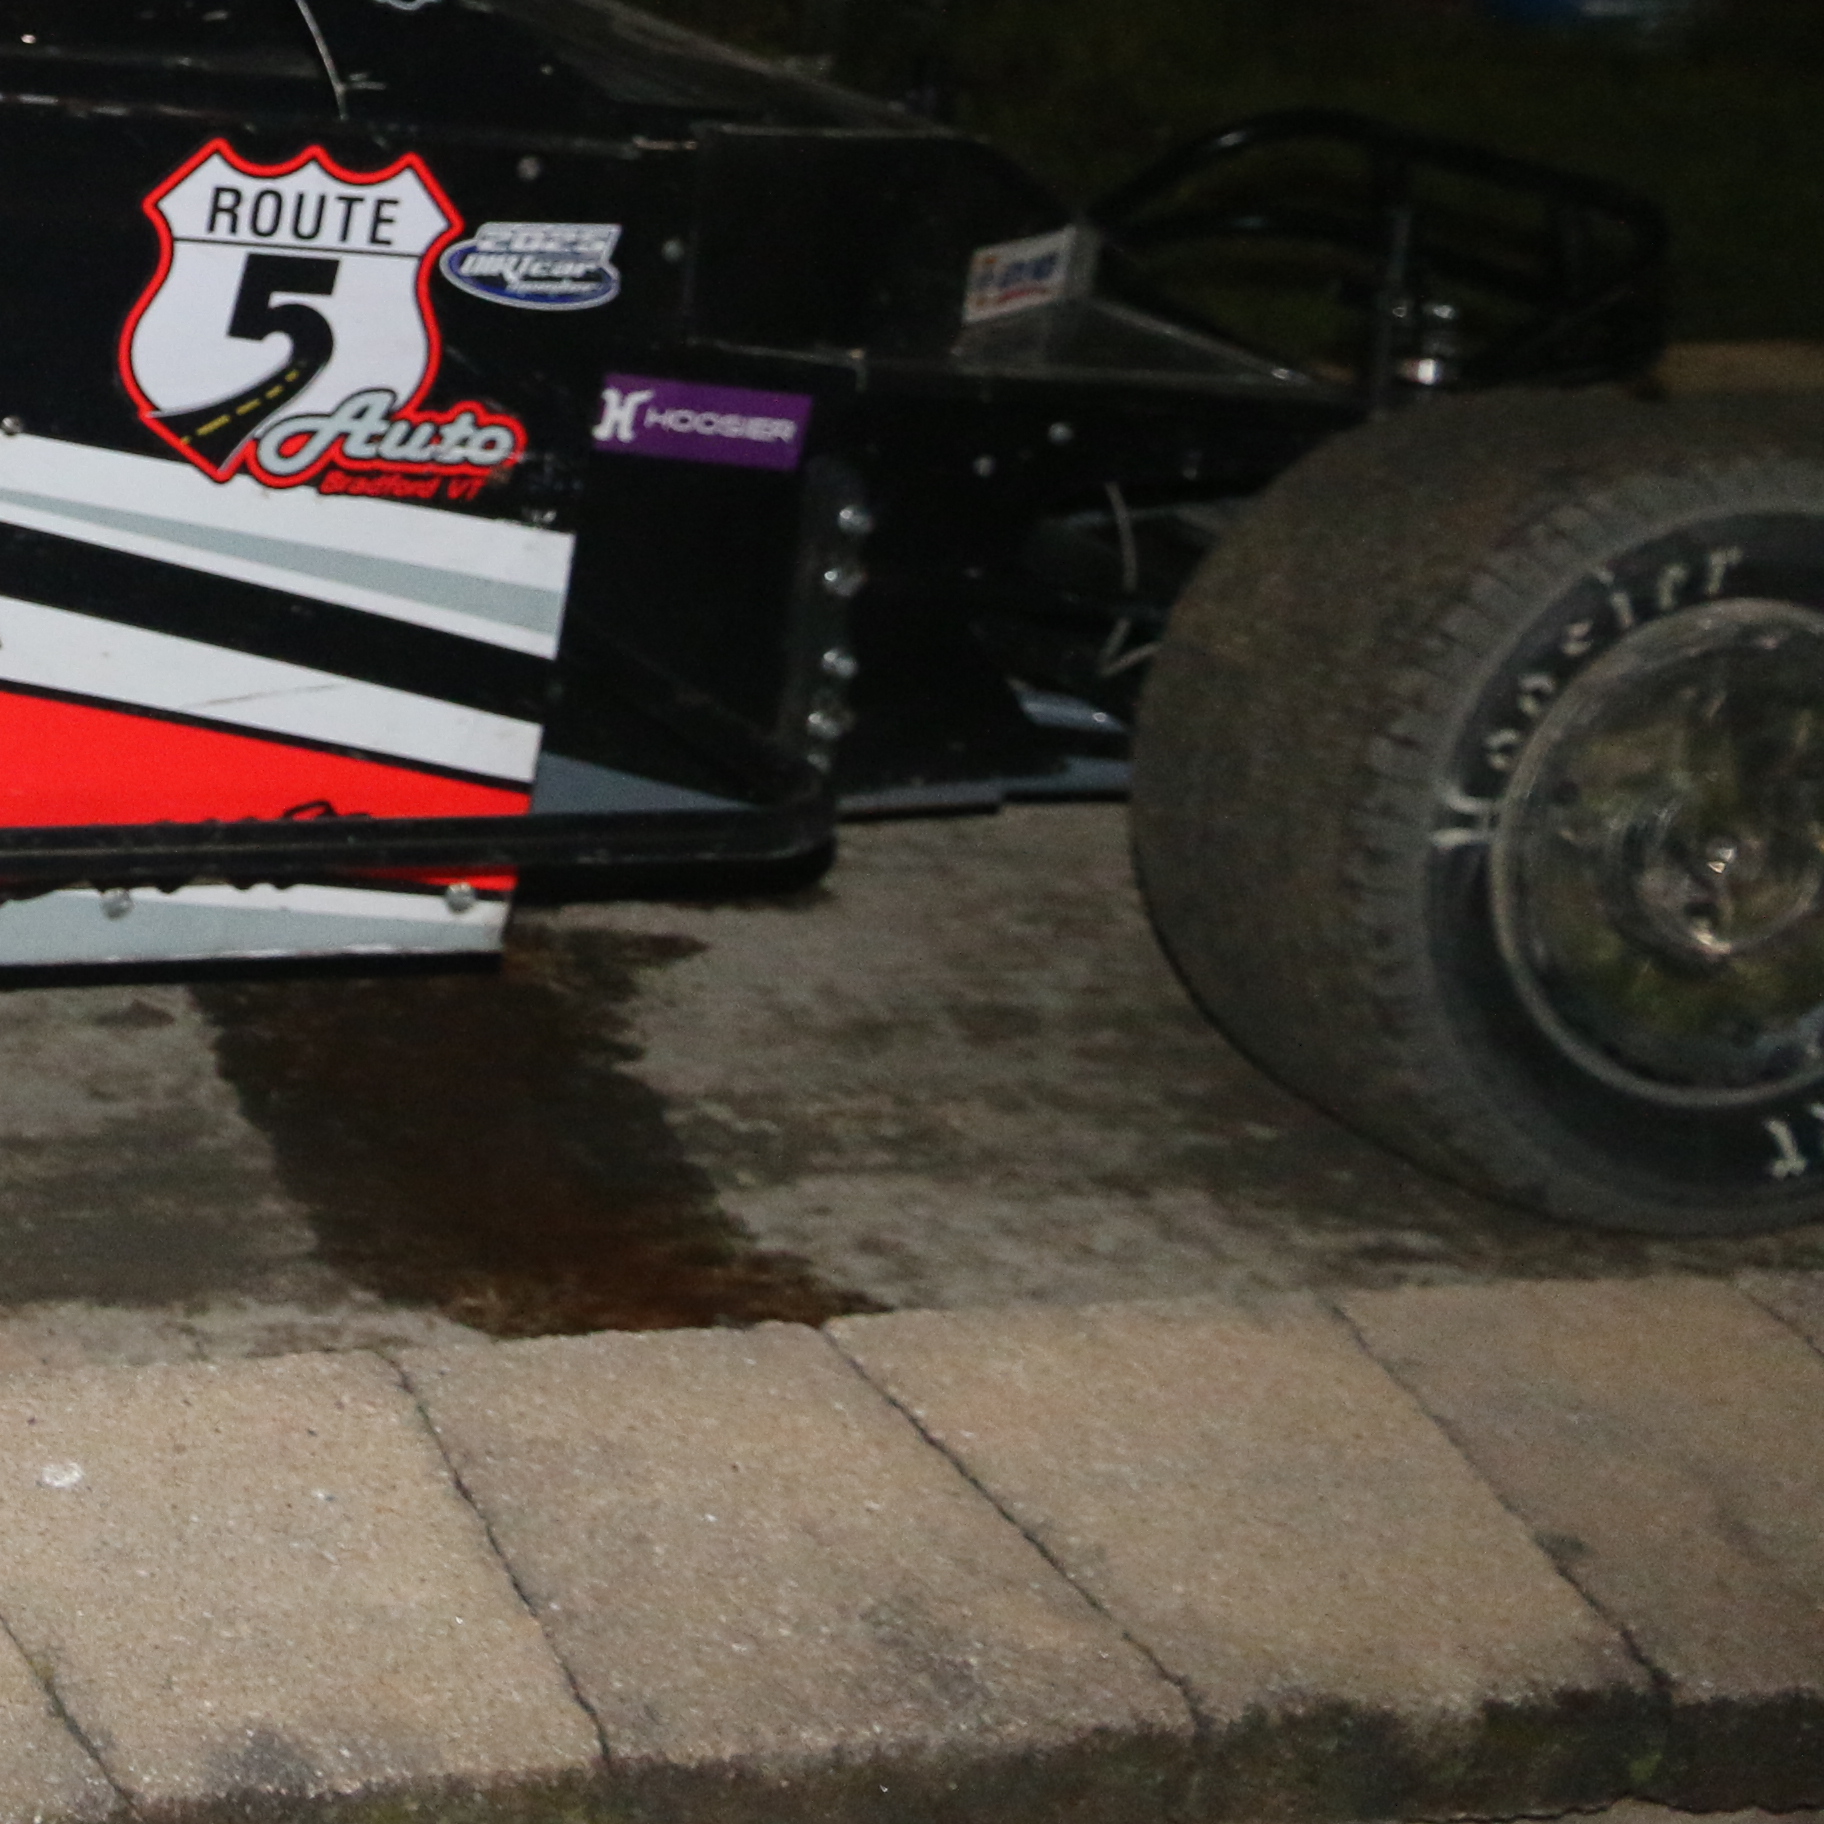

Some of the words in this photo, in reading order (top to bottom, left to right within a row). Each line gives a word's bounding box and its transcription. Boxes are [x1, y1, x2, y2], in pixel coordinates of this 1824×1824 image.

[204, 185, 402, 247] ROUTE
[256, 388, 520, 476] Auto
[643, 405, 799, 446] HOOSIER
